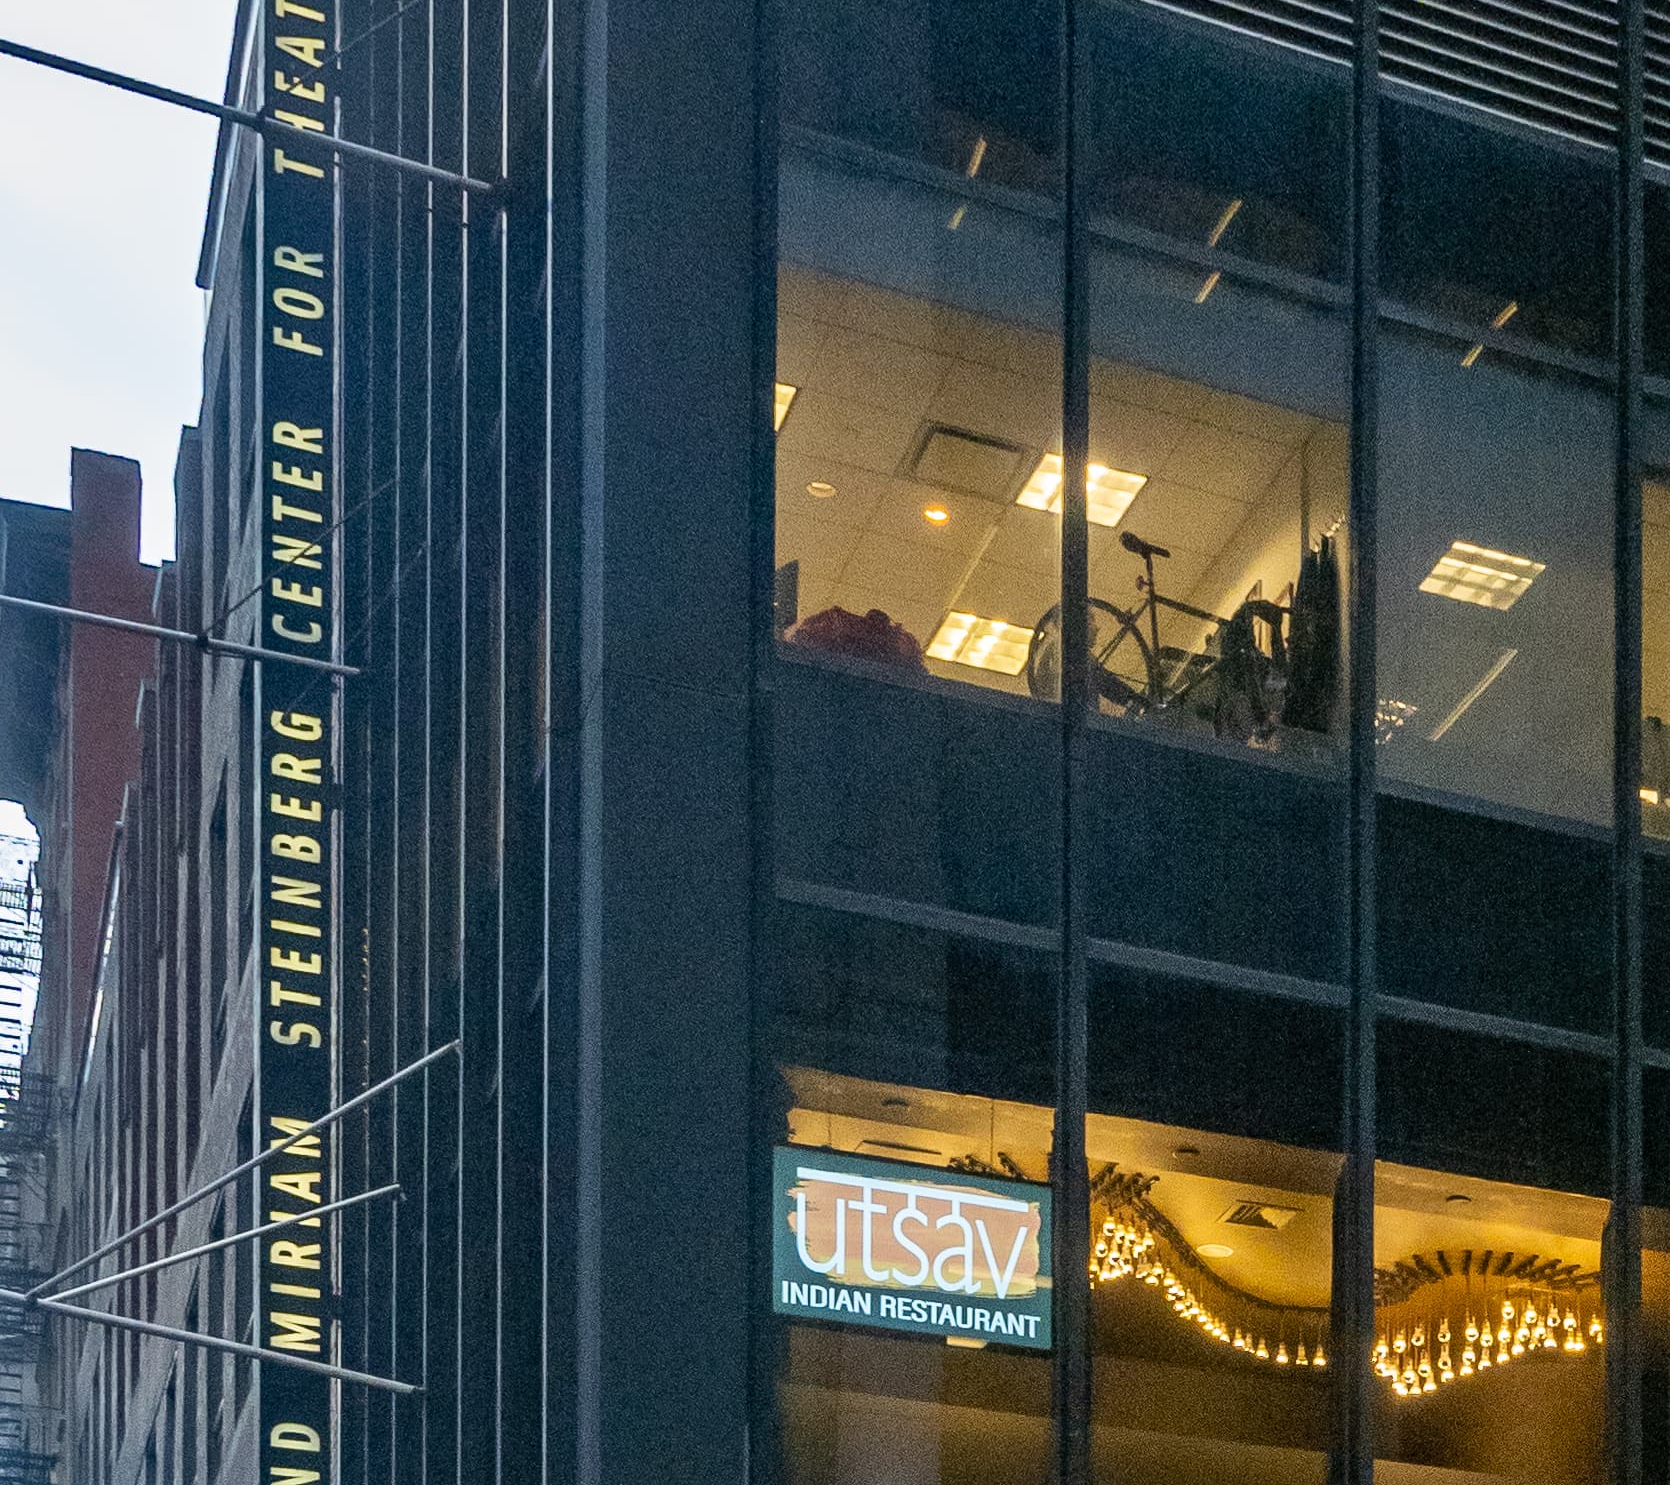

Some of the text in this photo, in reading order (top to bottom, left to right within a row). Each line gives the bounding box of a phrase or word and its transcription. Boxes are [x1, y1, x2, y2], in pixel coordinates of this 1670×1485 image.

[273, 244, 324, 356] FOR
[271, 419, 324, 643] CENTER
[270, 710, 322, 1048] STEINBERG
[270, 1115, 322, 1352] MIRIAM
[781, 1281, 1041, 1338] INDIAN RESTAURANT
[796, 1167, 1029, 1299] utsav
